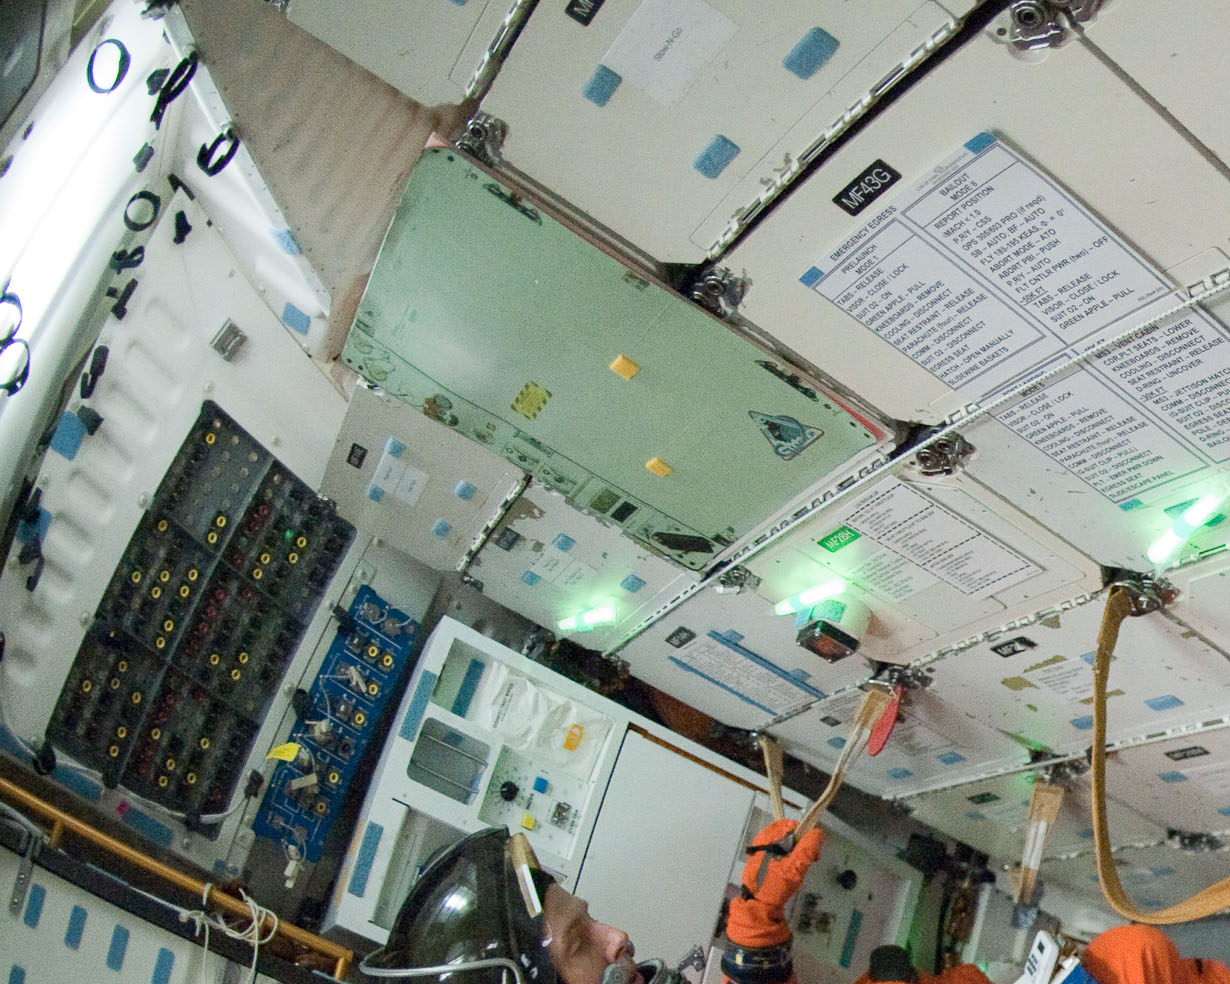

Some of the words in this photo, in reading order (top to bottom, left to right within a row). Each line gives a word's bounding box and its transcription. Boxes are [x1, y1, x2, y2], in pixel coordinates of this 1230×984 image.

[840, 167, 893, 210] MF43G
[939, 172, 969, 196] BAILOUT
[950, 184, 972, 200] MODE
[934, 207, 961, 229] REPORT
[960, 186, 994, 210] POSITION
[975, 215, 992, 228] CSS
[830, 227, 869, 261] EMERGENCY
[867, 205, 897, 229] EGRESS
[962, 238, 978, 251] OPS
[1000, 212, 1018, 224] PRO
[970, 248, 982, 258] SB
[1007, 223, 1018, 233] BF
[1024, 207, 1045, 223] AUTO
[989, 254, 1013, 272] ABORT
[1012, 241, 1035, 257] MODE
[1039, 228, 1056, 240] ATO
[841, 244, 877, 273] PRELAUNCH
[855, 259, 875, 274] MODE
[979, 253, 994, 265] FLY
[998, 261, 1022, 279] ABORT
[1021, 254, 1036, 264] PBI
[1038, 238, 1060, 253] PUSH
[1014, 282, 1029, 293] FLT
[1028, 268, 1053, 285] CNTLR
[1051, 258, 1070, 271] PWR
[1092, 235, 1108, 248] OFF
[1030, 257, 1051, 272] AUTO
[836, 292, 854, 305] TABS
[855, 268, 884, 290] RELEASE
[846, 297, 865, 312] VISOR
[867, 278, 888, 296] CLOSE
[889, 263, 909, 278] LOCK
[855, 307, 870, 319] SUIT
[880, 290, 892, 300] ON
[865, 310, 886, 325] GREEN
[884, 295, 905, 311] APPLE
[907, 281, 926, 294] PULL
[875, 302, 914, 332] KNEEBOARDS
[916, 280, 944, 301] REMOVE
[1033, 294, 1054, 308] TABS
[1057, 273, 1092, 294] RELEASE
[1034, 286, 1048, 297] FT
[1041, 300, 1065, 315] VISOR
[1068, 283, 1095, 300] CLOSE
[1096, 269, 1120, 284] LOCK
[1059, 313, 1084, 329] GREEN
[1084, 300, 1109, 316] APPLE
[1112, 287, 1134, 300] PULL
[884, 319, 911, 339] COOLING
[913, 288, 952, 318] DISCONNECT
[893, 333, 909, 346] SEAT
[907, 310, 940, 335] RESTRAINT
[944, 287, 974, 309] RELEASE
[902, 326, 938, 352] PARACHUTE
[956, 293, 987, 314] RELEASE
[1050, 310, 1067, 322] SUIT
[1082, 295, 1095, 304] ON
[911, 345, 930, 359] COMM
[933, 316, 972, 344] DISCONNECT
[920, 354, 935, 366] SUIT
[946, 320, 985, 348] DISCONNECT
[940, 364, 960, 378] HATCH
[962, 350, 982, 363] OPEN
[979, 329, 1013, 352] MANUALLY
[1111, 346, 1160, 372] KNEEBOARDS
[1165, 327, 1199, 345] REMOVE
[1132, 336, 1158, 351] SEATS
[1162, 319, 1192, 336] LOWER
[929, 355, 954, 372] EGRESS
[952, 344, 970, 357] SEAT
[948, 364, 980, 385] SLIDEWIRE
[978, 346, 1008, 366] BASKETS
[1119, 361, 1153, 379] COOLING
[1157, 335, 1205, 361] DISCONNECT
[1127, 374, 1146, 385] SEAT
[1145, 356, 1184, 377] RESTRAINT
[1188, 337, 1224, 357] RELEASE
